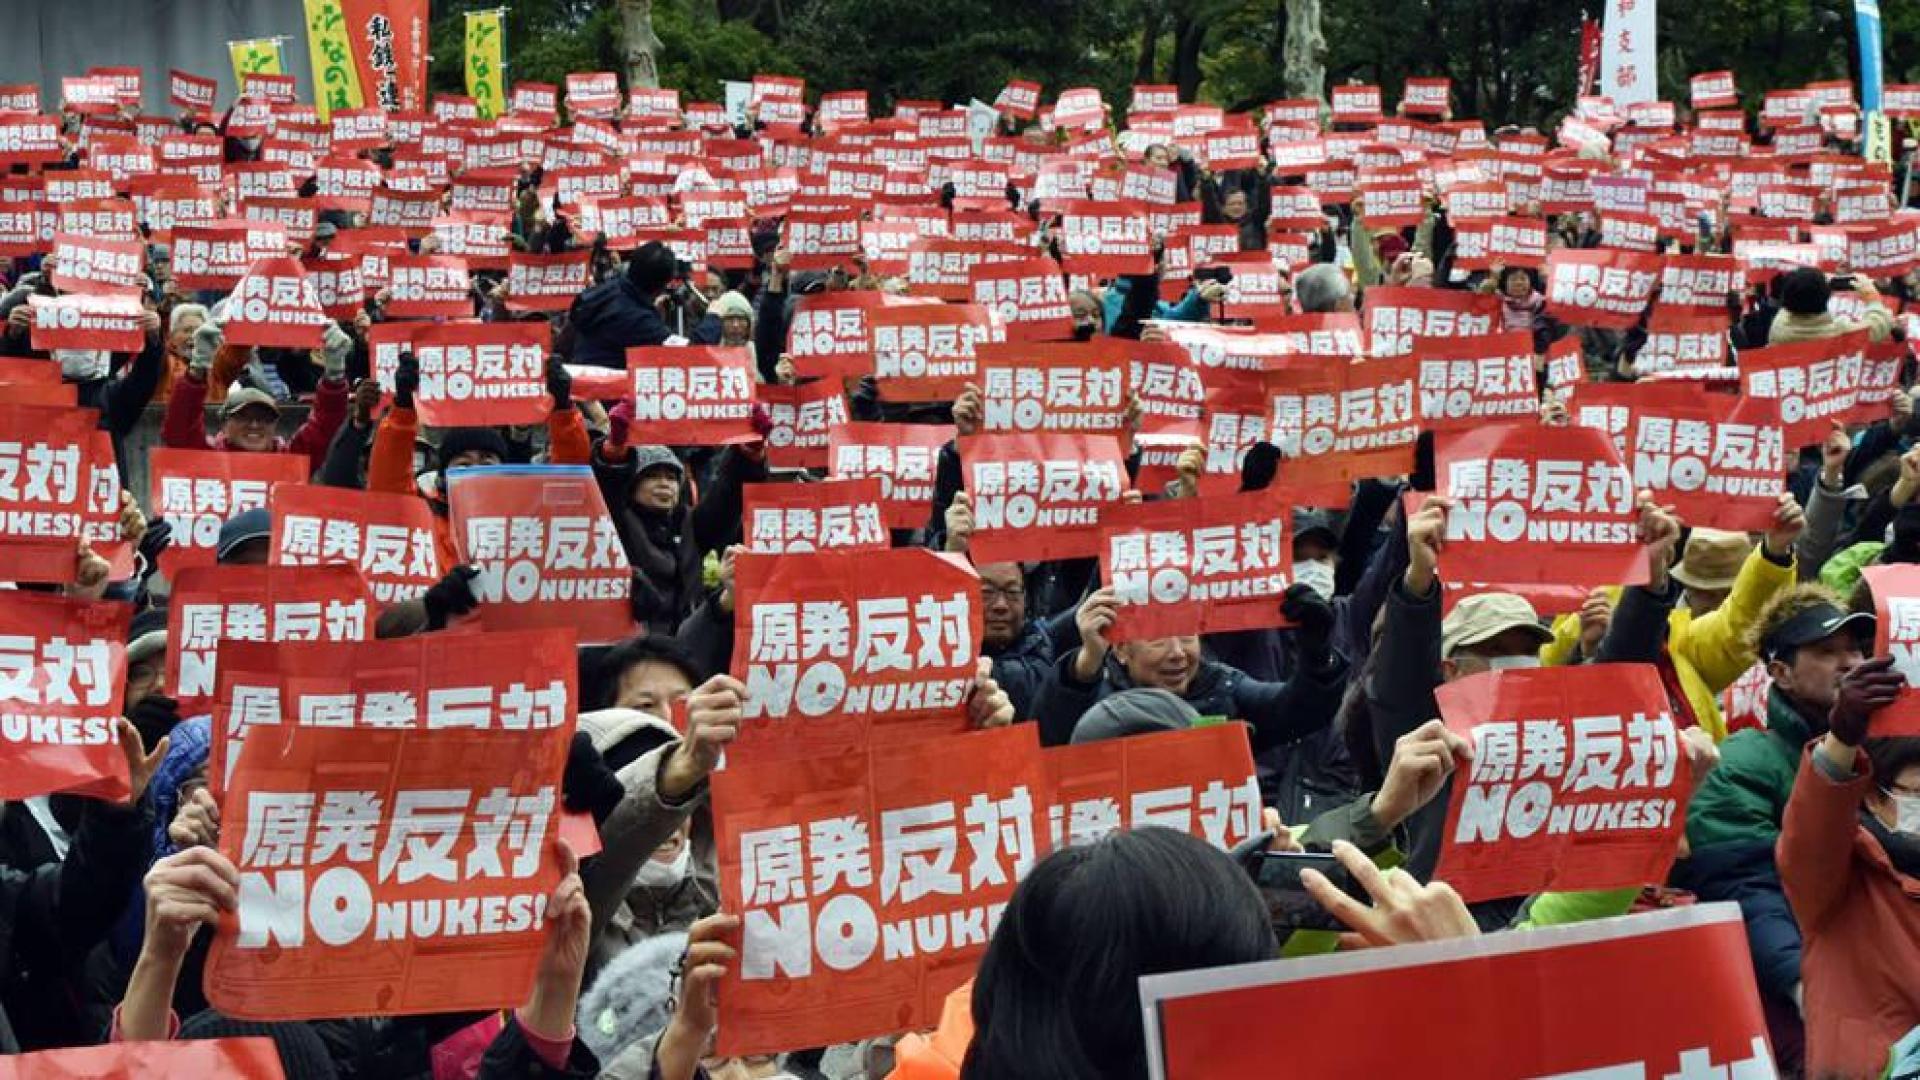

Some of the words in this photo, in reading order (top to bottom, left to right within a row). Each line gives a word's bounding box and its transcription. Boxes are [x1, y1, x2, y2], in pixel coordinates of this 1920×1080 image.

[1552, 285, 1597, 307] NO
[1554, 263, 1658, 297] 原発反対
[37, 306, 80, 328] NO
[419, 343, 543, 379] 原発反対
[792, 331, 834, 356] NO
[636, 366, 752, 400] 原発反対
[875, 350, 927, 378] NO
[1420, 356, 1534, 396] 原発反対
[1750, 353, 1863, 398] 原発反対
[420, 374, 474, 401] NO
[475, 382, 545, 398] NUKES!
[984, 366, 1122, 406] 原発反対
[1420, 390, 1472, 418] NO
[636, 393, 686, 420] NO
[984, 399, 1043, 430] NO
[1270, 380, 1412, 433] 原発反対
[1272, 425, 1339, 458] NO
[1635, 417, 1784, 472] 原発反対
[973, 461, 1121, 502] 原発反対
[1448, 459, 1634, 514] 原発反対
[1636, 454, 1706, 490] NO
[170, 514, 222, 547] NO
[753, 503, 885, 549] 原発反対
[975, 494, 1037, 529] NO
[1447, 500, 1527, 542] NO
[1527, 520, 1637, 544] NUKES!
[467, 515, 632, 570] 原発反対
[1110, 519, 1282, 576] 原発反対
[475, 560, 540, 603] NO
[540, 578, 631, 601] NUKES!
[1112, 568, 1190, 605] NO
[1190, 574, 1290, 600] NUKES!
[749, 593, 972, 673] 原発反対
[742, 662, 846, 718] NO
[846, 679, 975, 714] NUKES!
[1471, 712, 1678, 791] 原発反対
[1455, 782, 1552, 843] NO
[1547, 799, 1676, 835] NUKES!
[240, 786, 556, 884] 原発反対
[740, 785, 1035, 906] 原発反対
[236, 867, 373, 948] NO
[375, 893, 545, 941] NUKES!
[740, 895, 878, 980] NO
